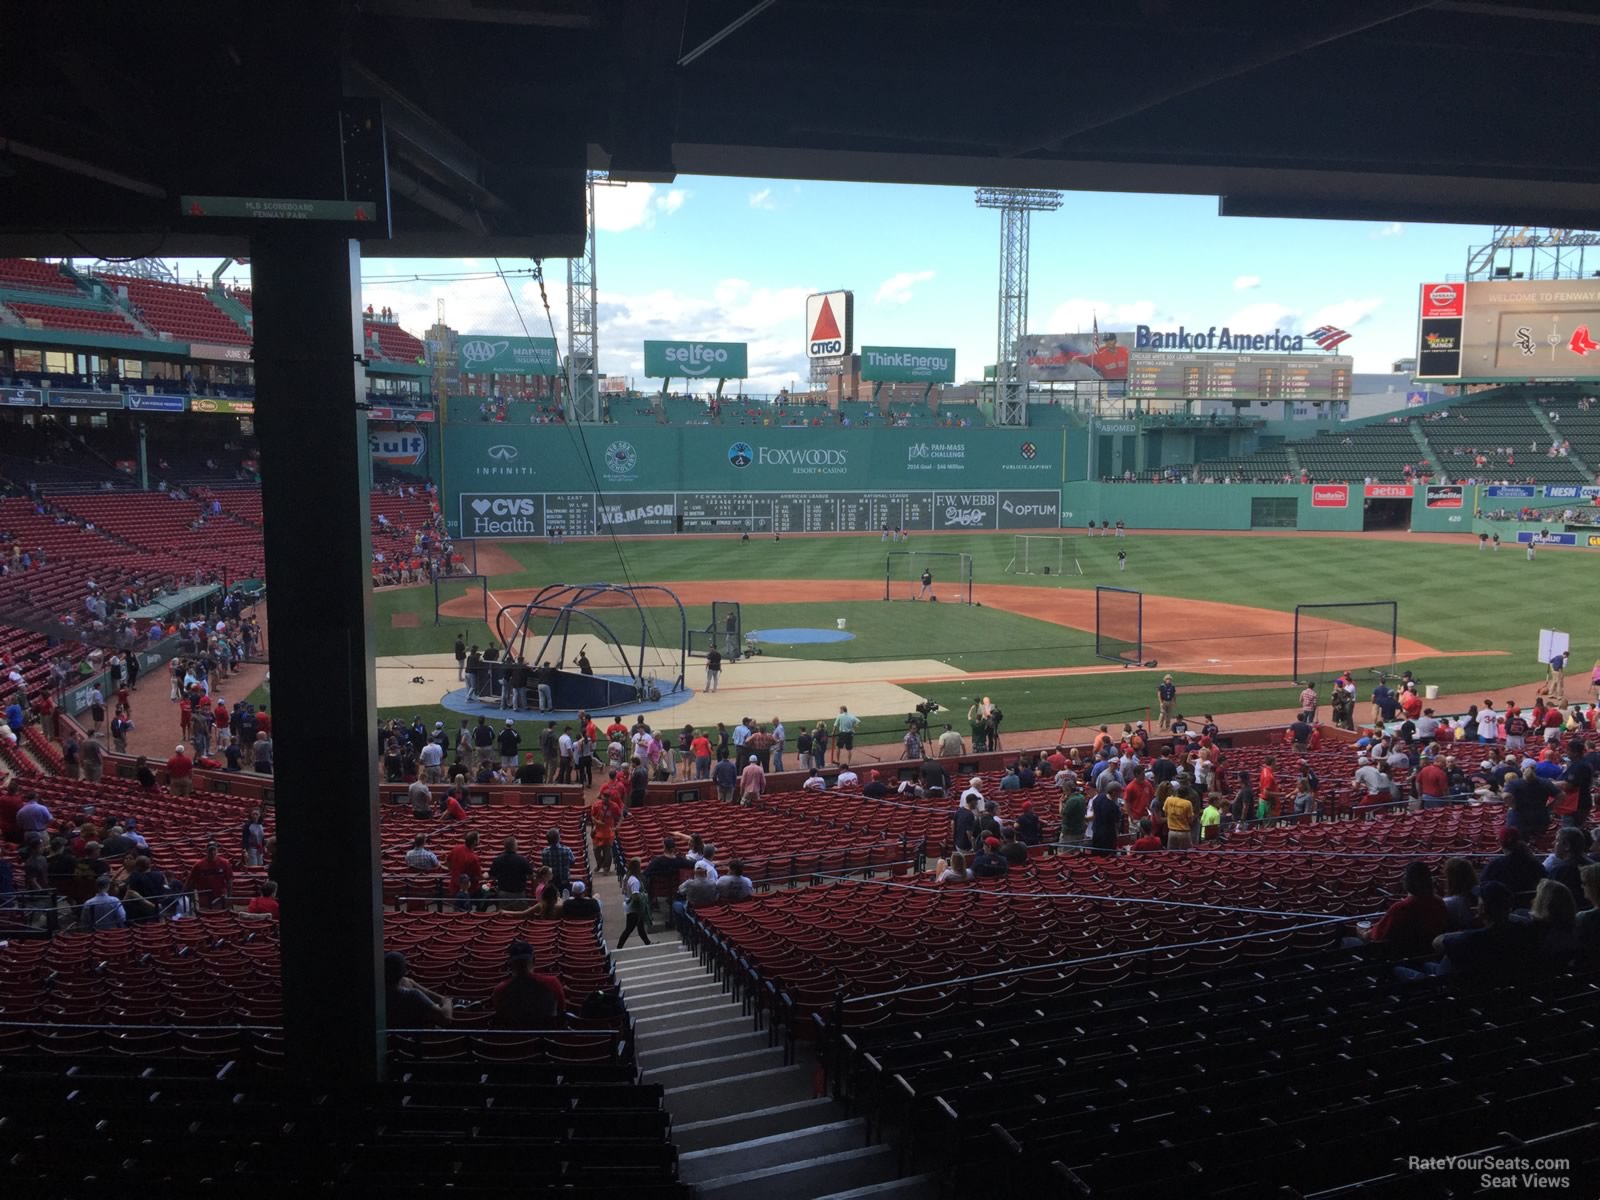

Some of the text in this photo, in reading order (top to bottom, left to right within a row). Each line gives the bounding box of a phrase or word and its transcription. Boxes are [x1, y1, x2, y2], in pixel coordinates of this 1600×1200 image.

[1489, 293, 1536, 302] WELCOME
[1540, 293, 1552, 301] TO
[1554, 292, 1596, 301] FENWAY
[1136, 325, 1303, 352] Bank of America
[467, 343, 492, 356] AAA
[811, 340, 842, 354] CITGO
[867, 352, 948, 370] ThinkEnergy
[1372, 486, 1406, 496] aetna
[1550, 488, 1576, 496] NESN
[492, 498, 534, 515] CVS
[936, 495, 996, 506] F.W. WEBB
[602, 504, 674, 524] W.B.MASON
[1015, 505, 1056, 515] OPTUM
[474, 517, 535, 533] Health
